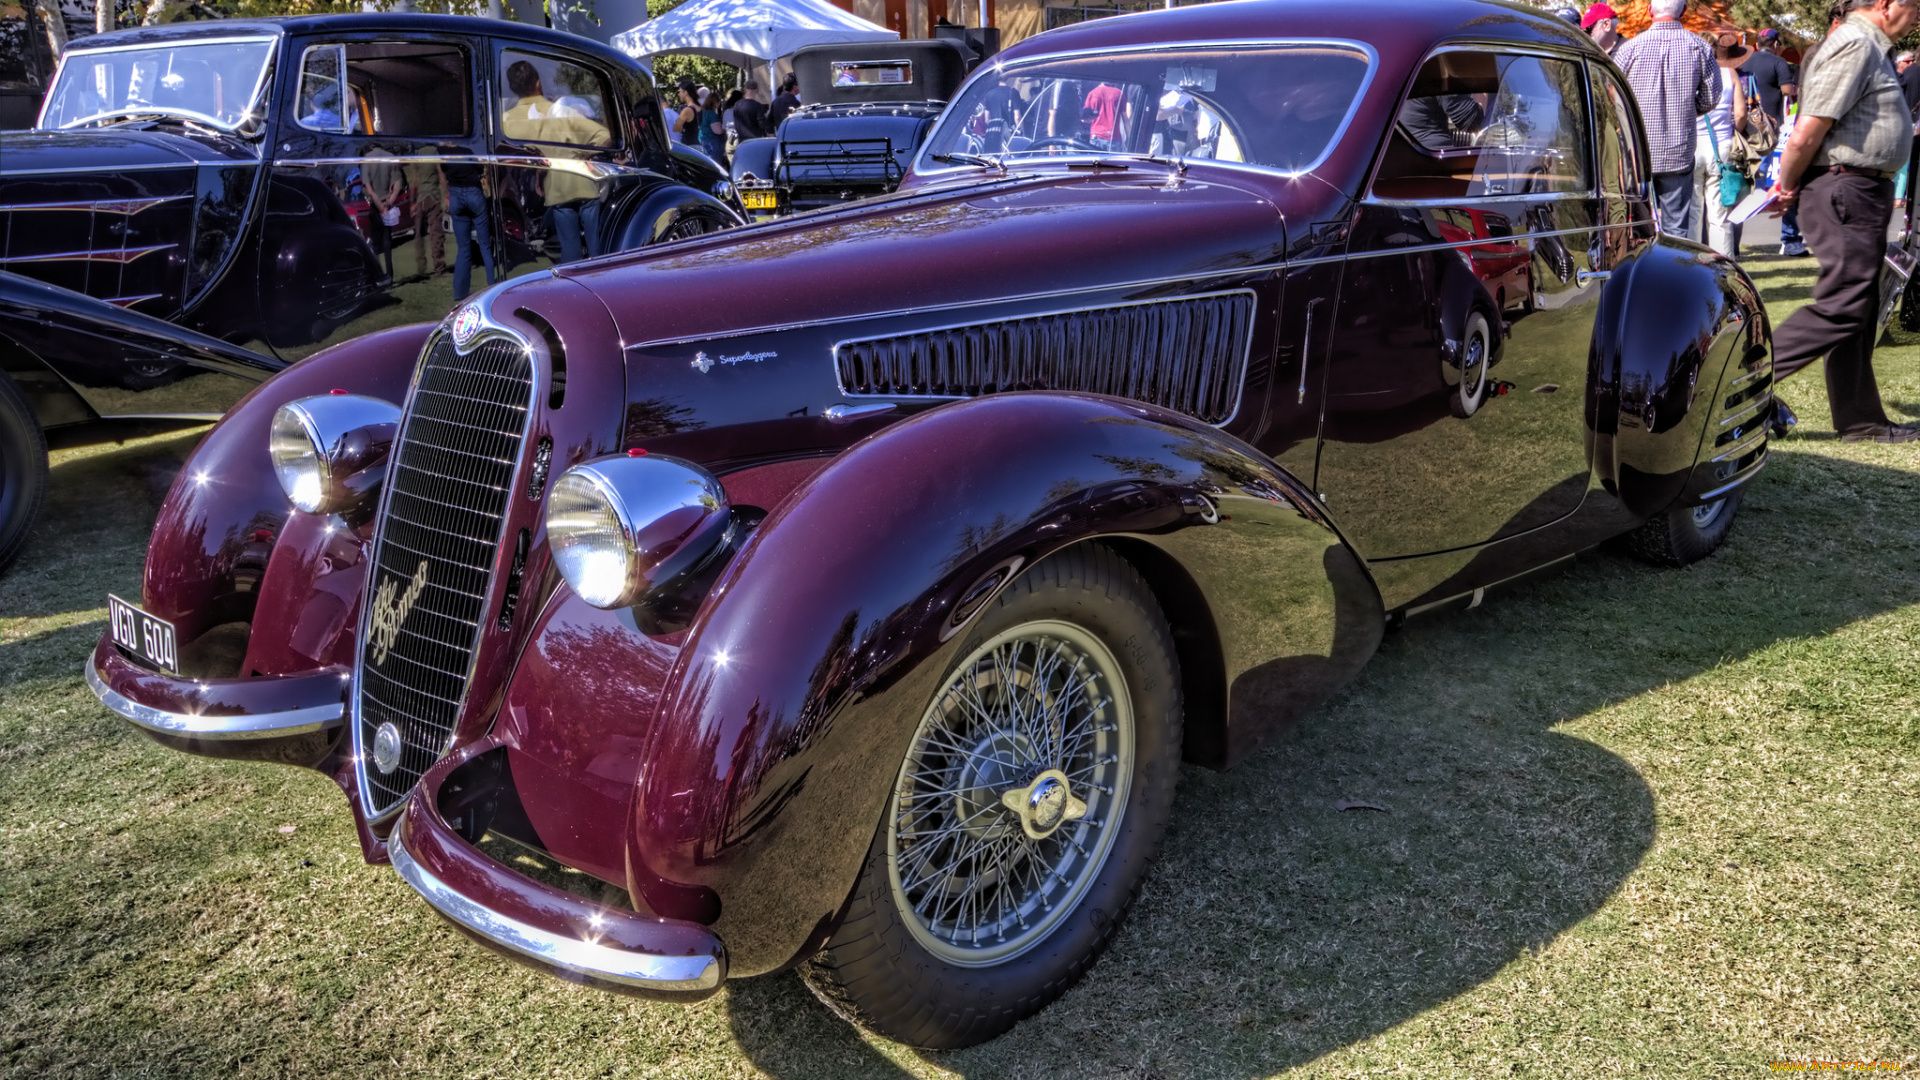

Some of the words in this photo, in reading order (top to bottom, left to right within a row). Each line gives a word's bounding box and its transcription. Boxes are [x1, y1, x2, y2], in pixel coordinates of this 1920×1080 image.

[110, 599, 137, 650] VGD
[143, 617, 174, 671] 604
[366, 574, 398, 645] Alfa
[373, 560, 428, 667] Romeo
